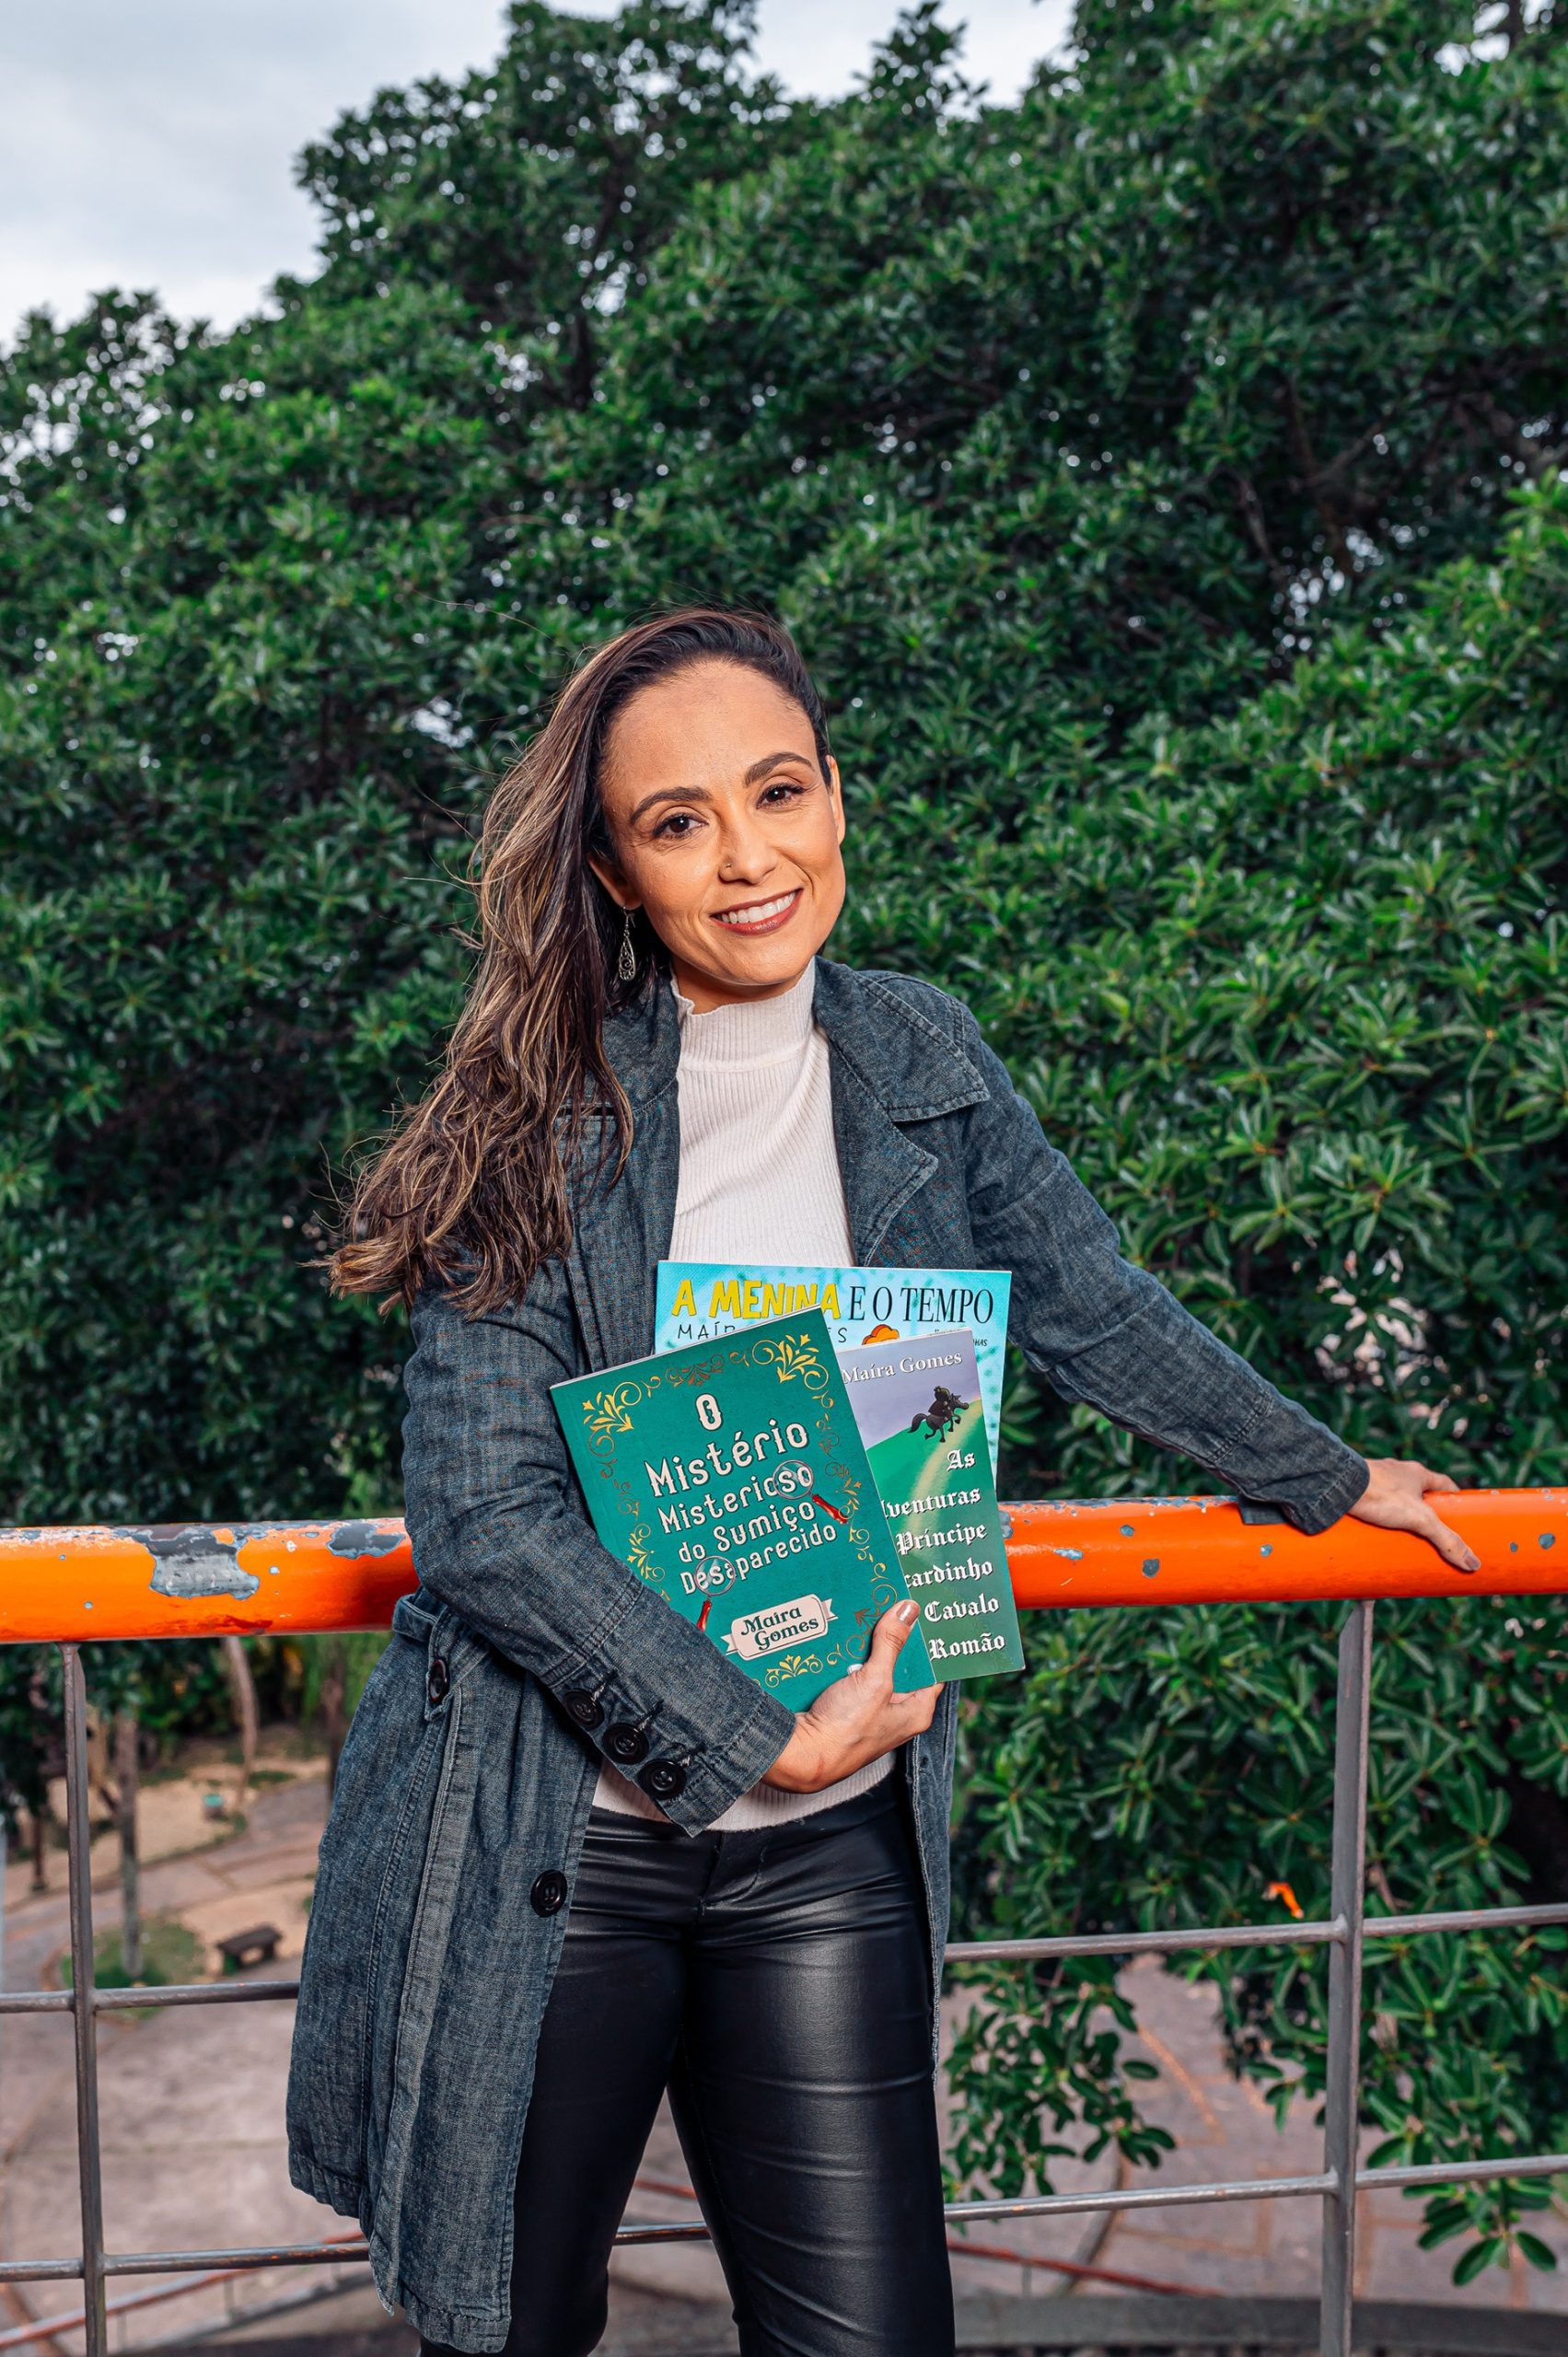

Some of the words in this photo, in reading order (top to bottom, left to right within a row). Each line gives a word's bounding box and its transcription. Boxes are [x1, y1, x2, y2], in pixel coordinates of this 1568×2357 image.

[671, 1279, 697, 1317] A
[708, 1280, 841, 1319] MENINA
[848, 1285, 866, 1320] E
[872, 1286, 893, 1321] O
[900, 1287, 993, 1324] TEMPO
[842, 1363, 896, 1384] Maíra
[899, 1353, 963, 1375] Gomes
[695, 1393, 723, 1431] O
[644, 1418, 809, 1497] Mistério
[947, 1448, 976, 1472] As
[657, 1465, 812, 1535] Misterioso
[881, 1487, 981, 1519] venturas
[678, 1541, 707, 1563] do
[713, 1502, 816, 1552] Sumiço
[895, 1523, 989, 1556] Príncipe
[679, 1523, 837, 1595] Desaparecido
[904, 1556, 993, 1588] cardinho
[923, 1593, 1000, 1623] Cavalo
[754, 1618, 819, 1651] Gomes
[928, 1632, 1006, 1661] Romão
